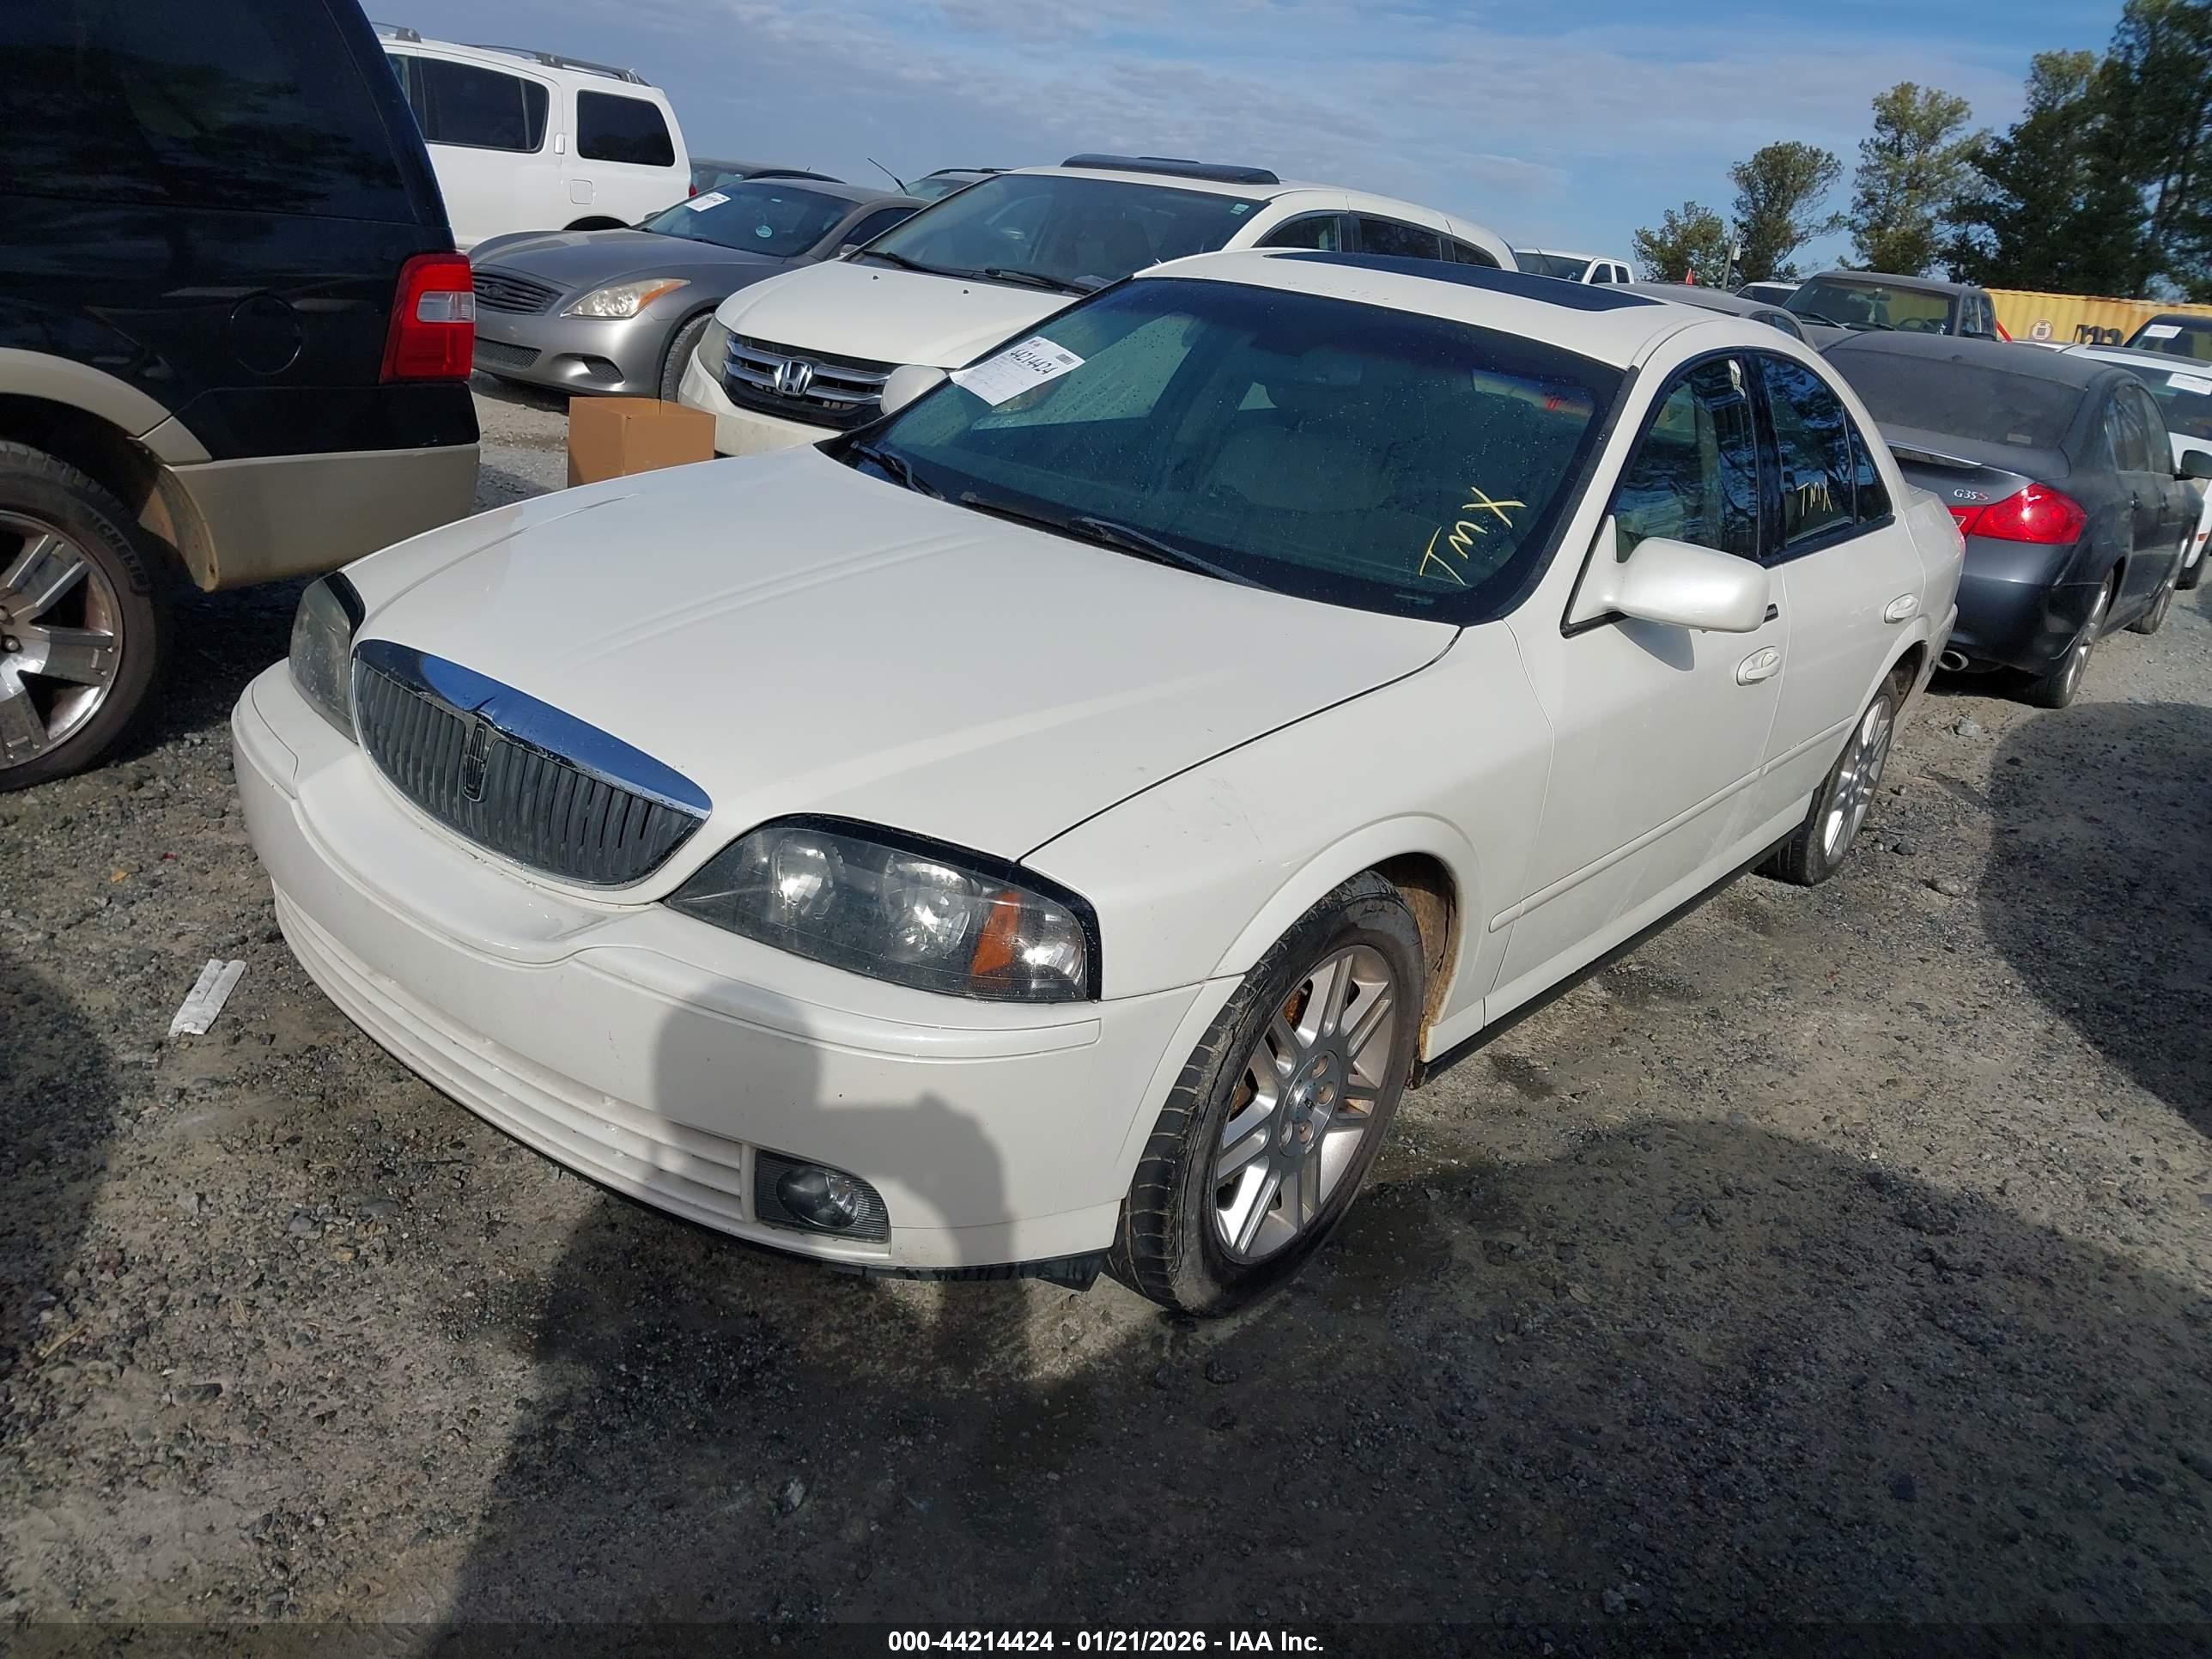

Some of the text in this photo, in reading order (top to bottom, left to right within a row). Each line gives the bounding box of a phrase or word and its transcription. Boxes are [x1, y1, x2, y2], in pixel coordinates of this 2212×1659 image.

[1008, 349, 1059, 375] 44214424
[1796, 475, 1833, 517] TMX
[1419, 486, 1528, 586] TMX
